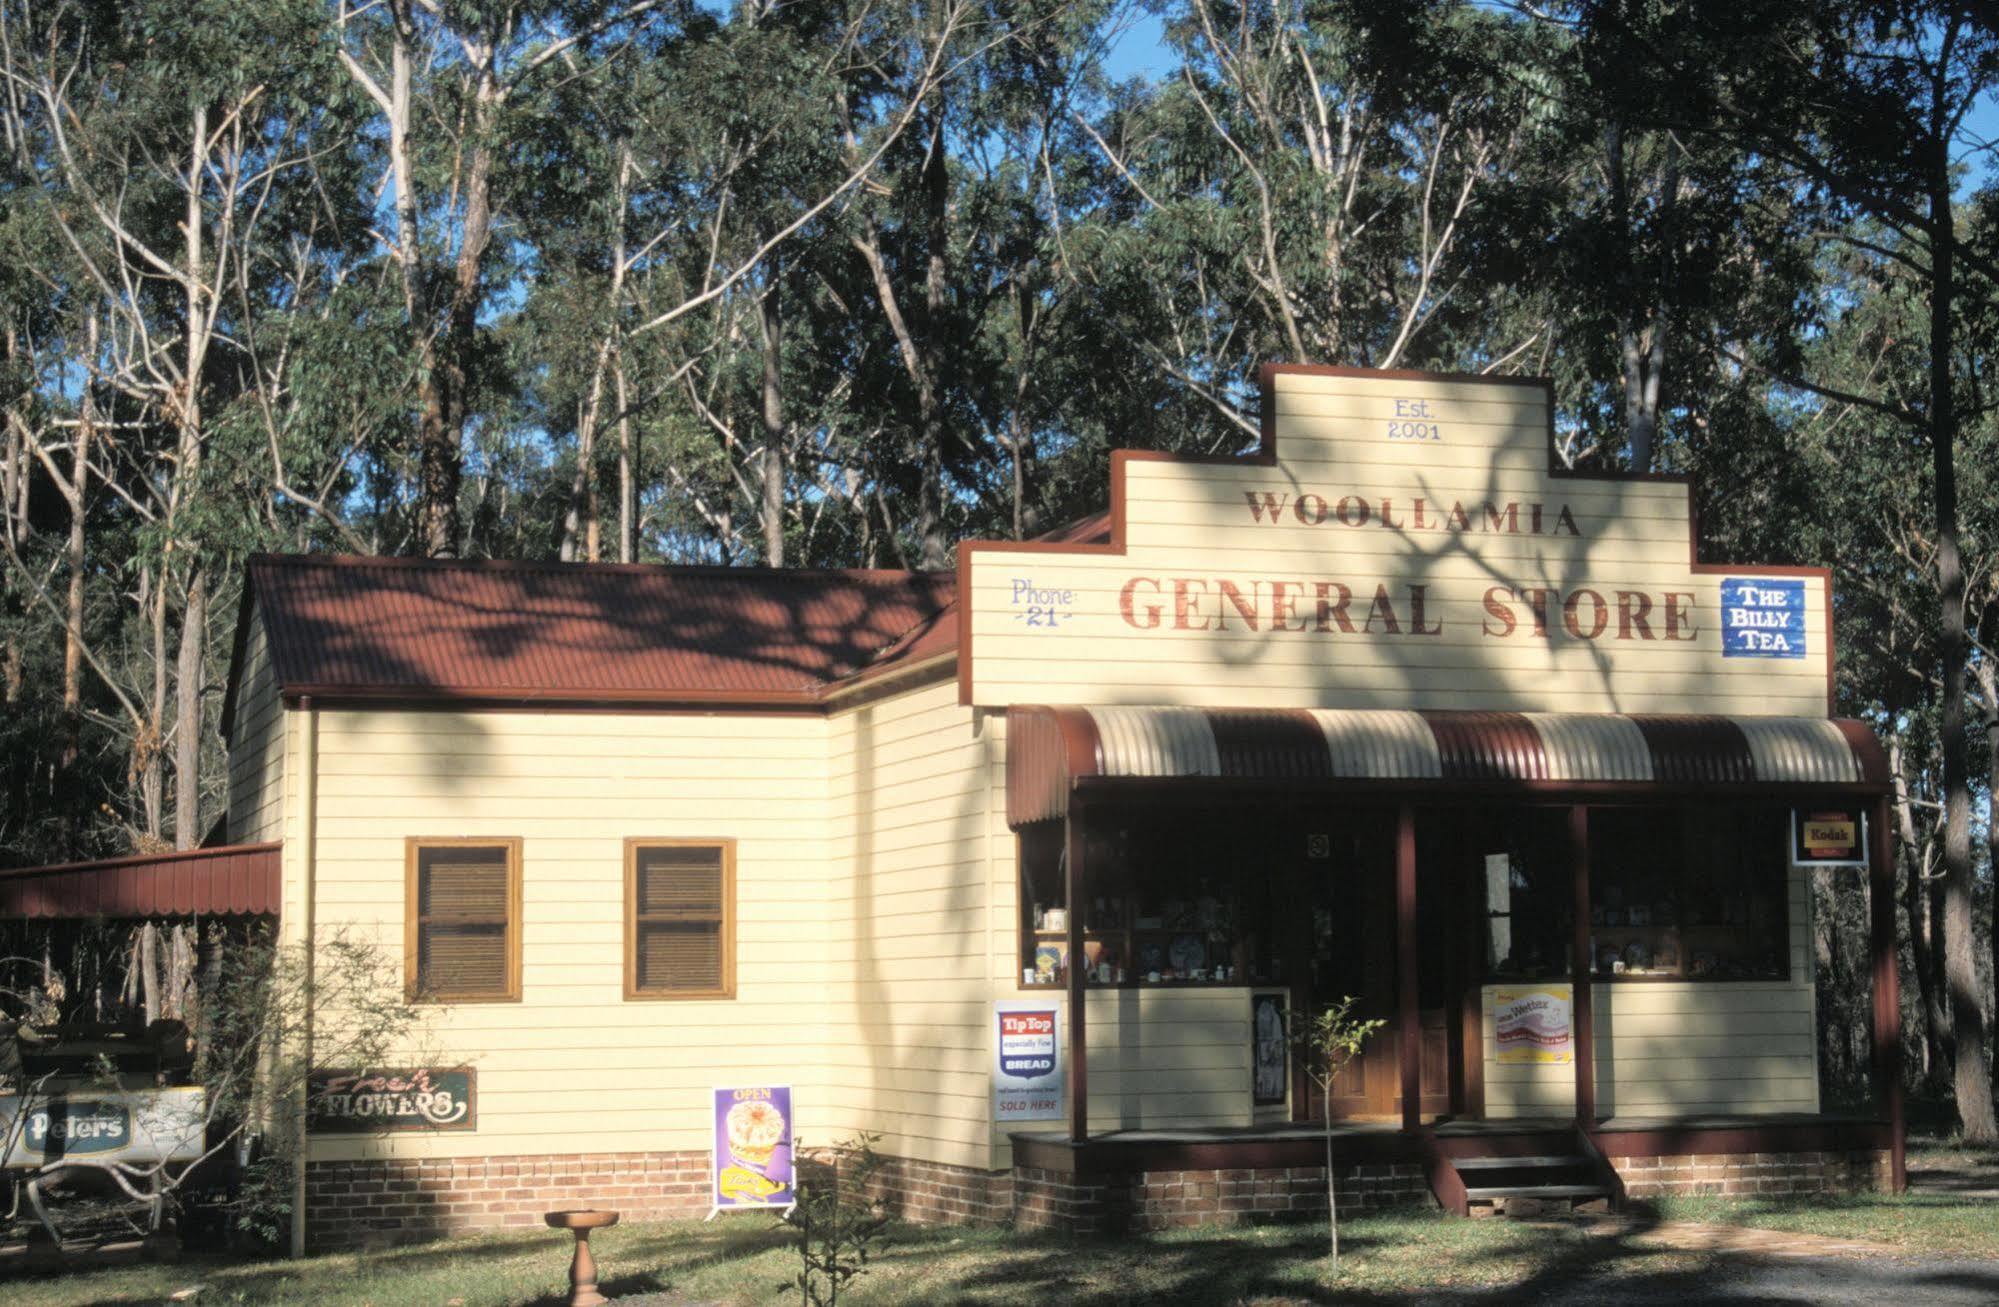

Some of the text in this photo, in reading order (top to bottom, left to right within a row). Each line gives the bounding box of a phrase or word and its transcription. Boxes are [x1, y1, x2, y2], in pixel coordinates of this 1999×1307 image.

[1394, 399, 1436, 419] Est.
[1388, 422, 1441, 440] 2001
[1245, 491, 1582, 536] WOOLLAMIA
[1737, 587, 1787, 607] THE
[1119, 577, 1699, 641] GENERAL STORE
[1729, 608, 1791, 628] BILLY
[1738, 630, 1790, 651] TEA
[1810, 828, 1848, 841] Kodak
[1003, 1017, 1052, 1033] Tip Top
[1005, 1060, 1051, 1070] BREAD
[733, 1088, 771, 1101] OPEN
[326, 1092, 467, 1124] FLOWERS
[1000, 1100, 1056, 1111] SOLD HERE
[31, 1112, 124, 1140] Peters
